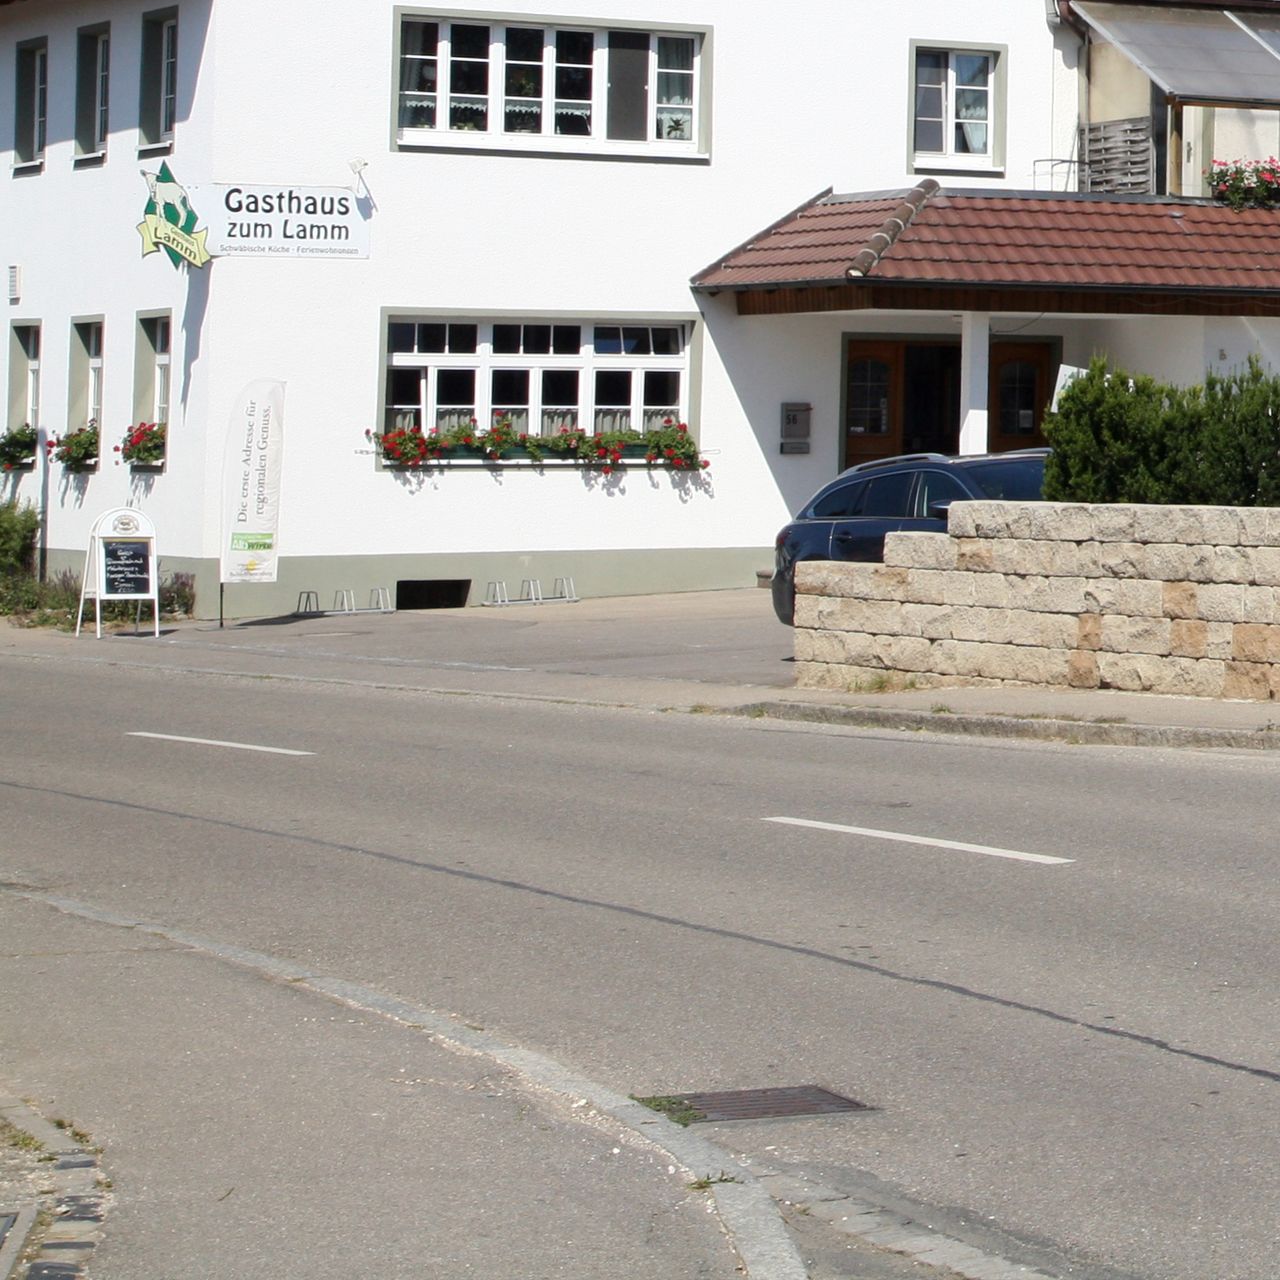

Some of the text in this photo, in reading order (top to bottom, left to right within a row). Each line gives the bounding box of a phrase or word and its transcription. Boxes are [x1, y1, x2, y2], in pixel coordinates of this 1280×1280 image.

[224, 188, 350, 215] Gasthaus
[153, 227, 197, 261] Lamm
[227, 220, 349, 241] zum Lamm
[242, 420, 255, 466] Adresse
[241, 470, 250, 498] erste
[255, 454, 268, 515] regionalen
[237, 501, 248, 522] Die
